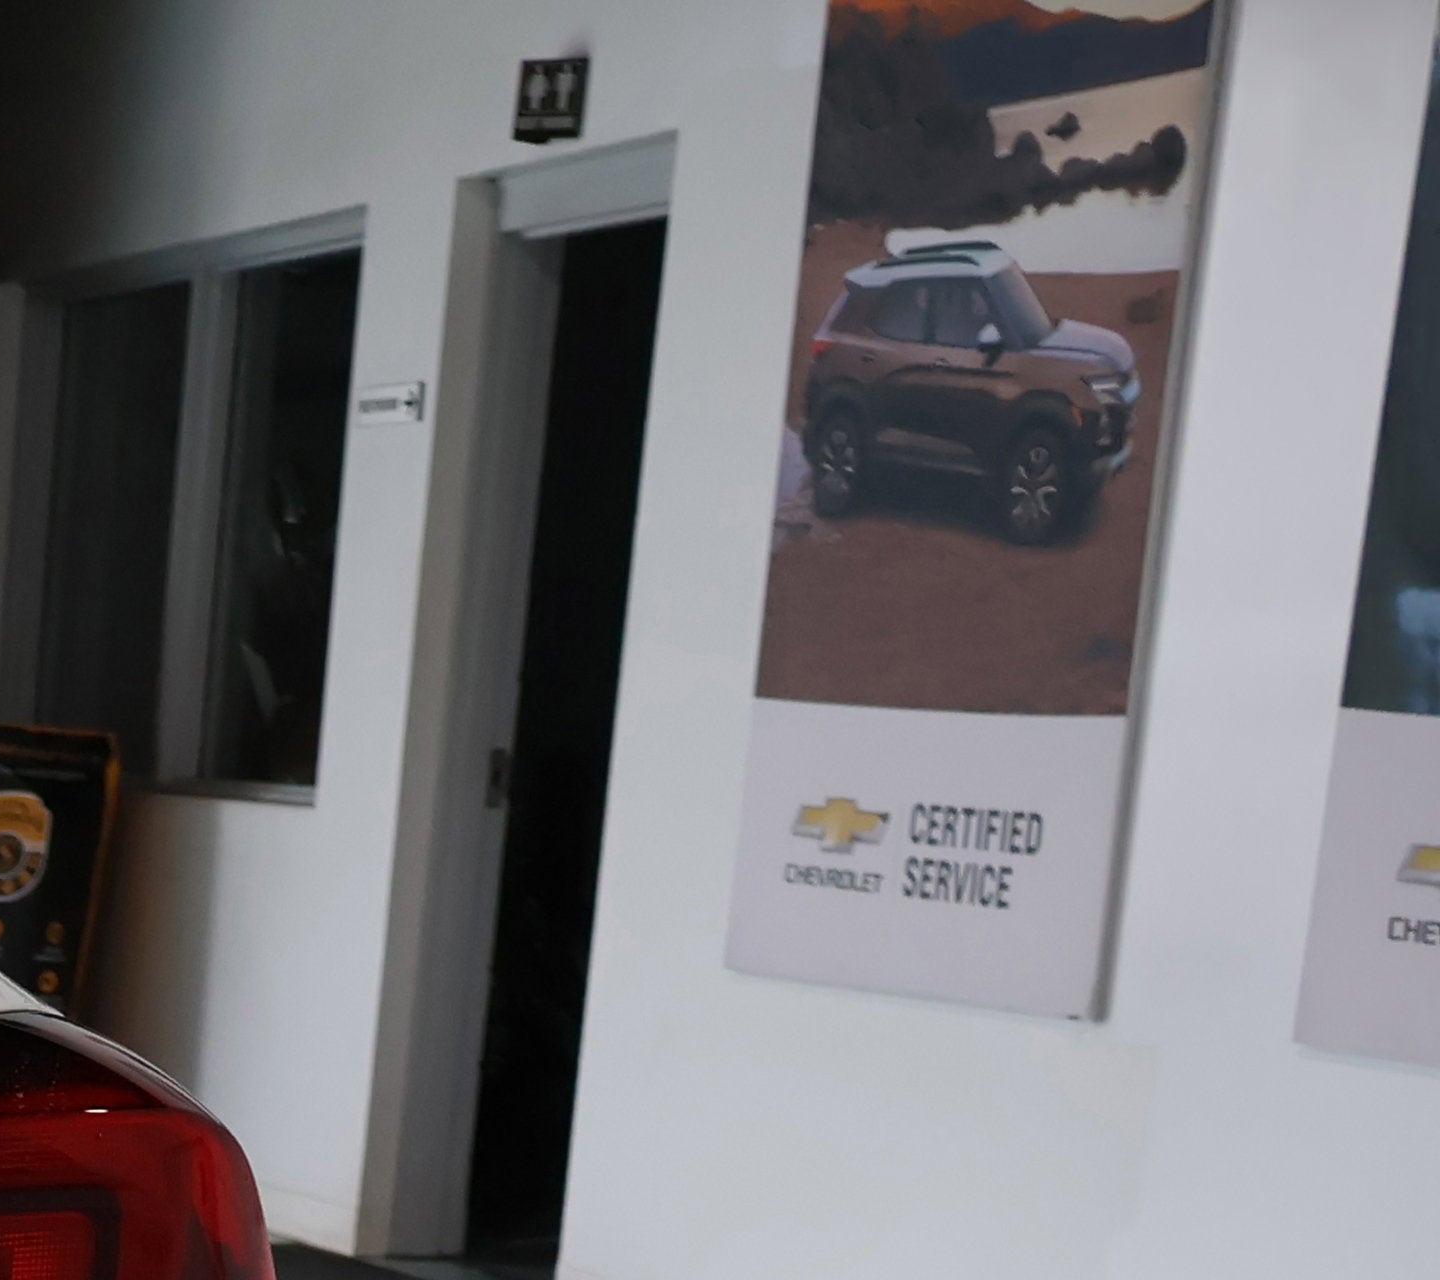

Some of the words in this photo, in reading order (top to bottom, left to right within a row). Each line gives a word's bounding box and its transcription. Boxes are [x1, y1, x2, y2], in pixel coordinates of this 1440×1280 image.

[908, 802, 1043, 856] CERTIFIED
[784, 862, 885, 894] CHEVROLET
[901, 856, 1014, 909] SERVICE
[1387, 916, 1440, 946] CHE
